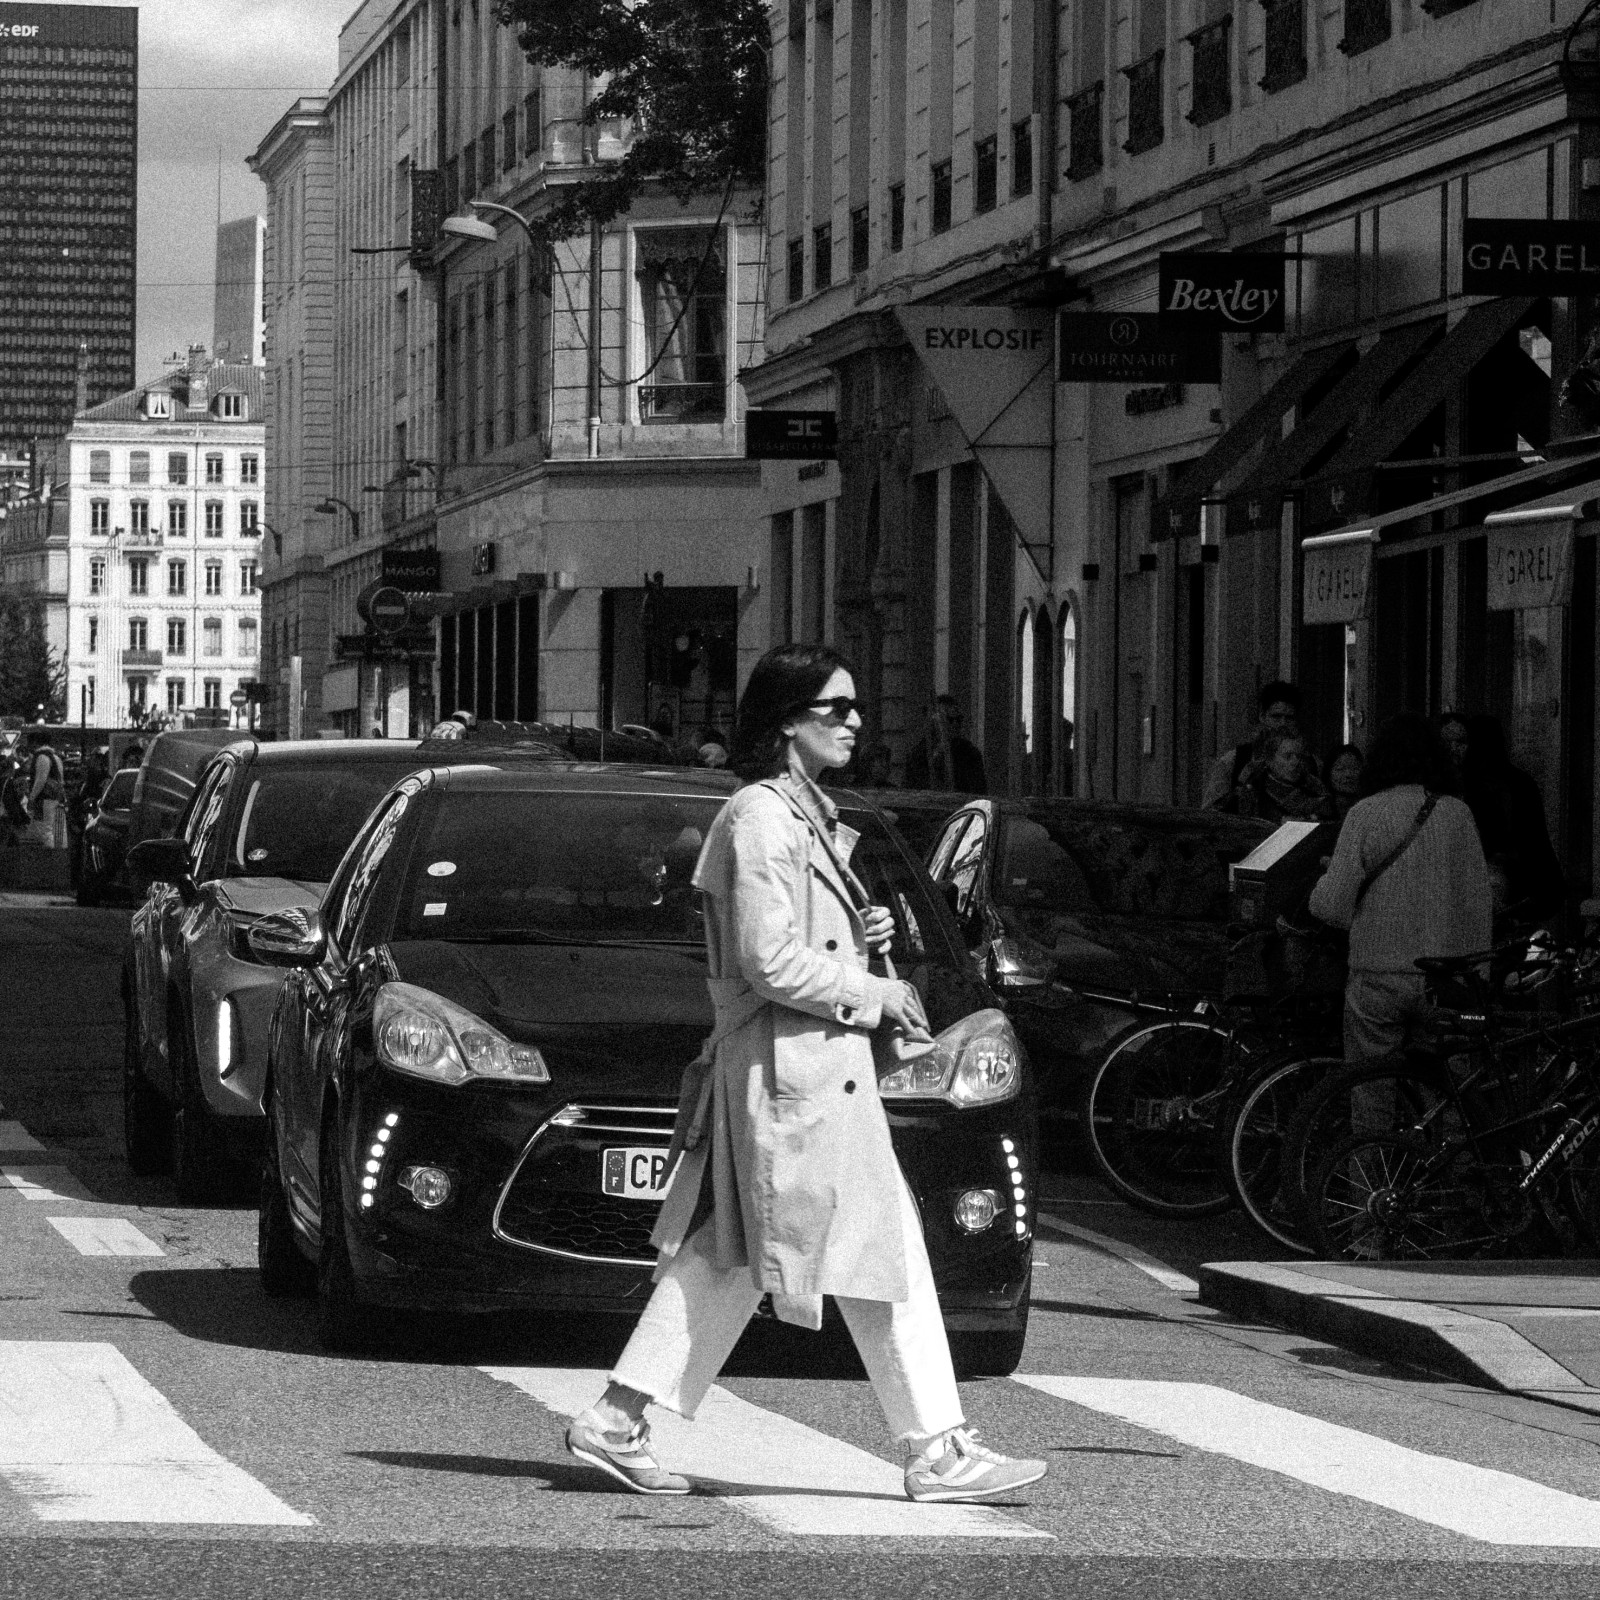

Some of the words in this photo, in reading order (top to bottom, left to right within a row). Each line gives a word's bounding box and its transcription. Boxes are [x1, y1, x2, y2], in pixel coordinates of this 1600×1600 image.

[1467, 243, 1600, 272] GAREL
[1166, 279, 1279, 323] Bexley
[926, 328, 1043, 350] EXPLOSIF
[1069, 352, 1178, 367] TOURNAIRE
[385, 566, 436, 577] MANGO
[1508, 547, 1552, 585] GAREL
